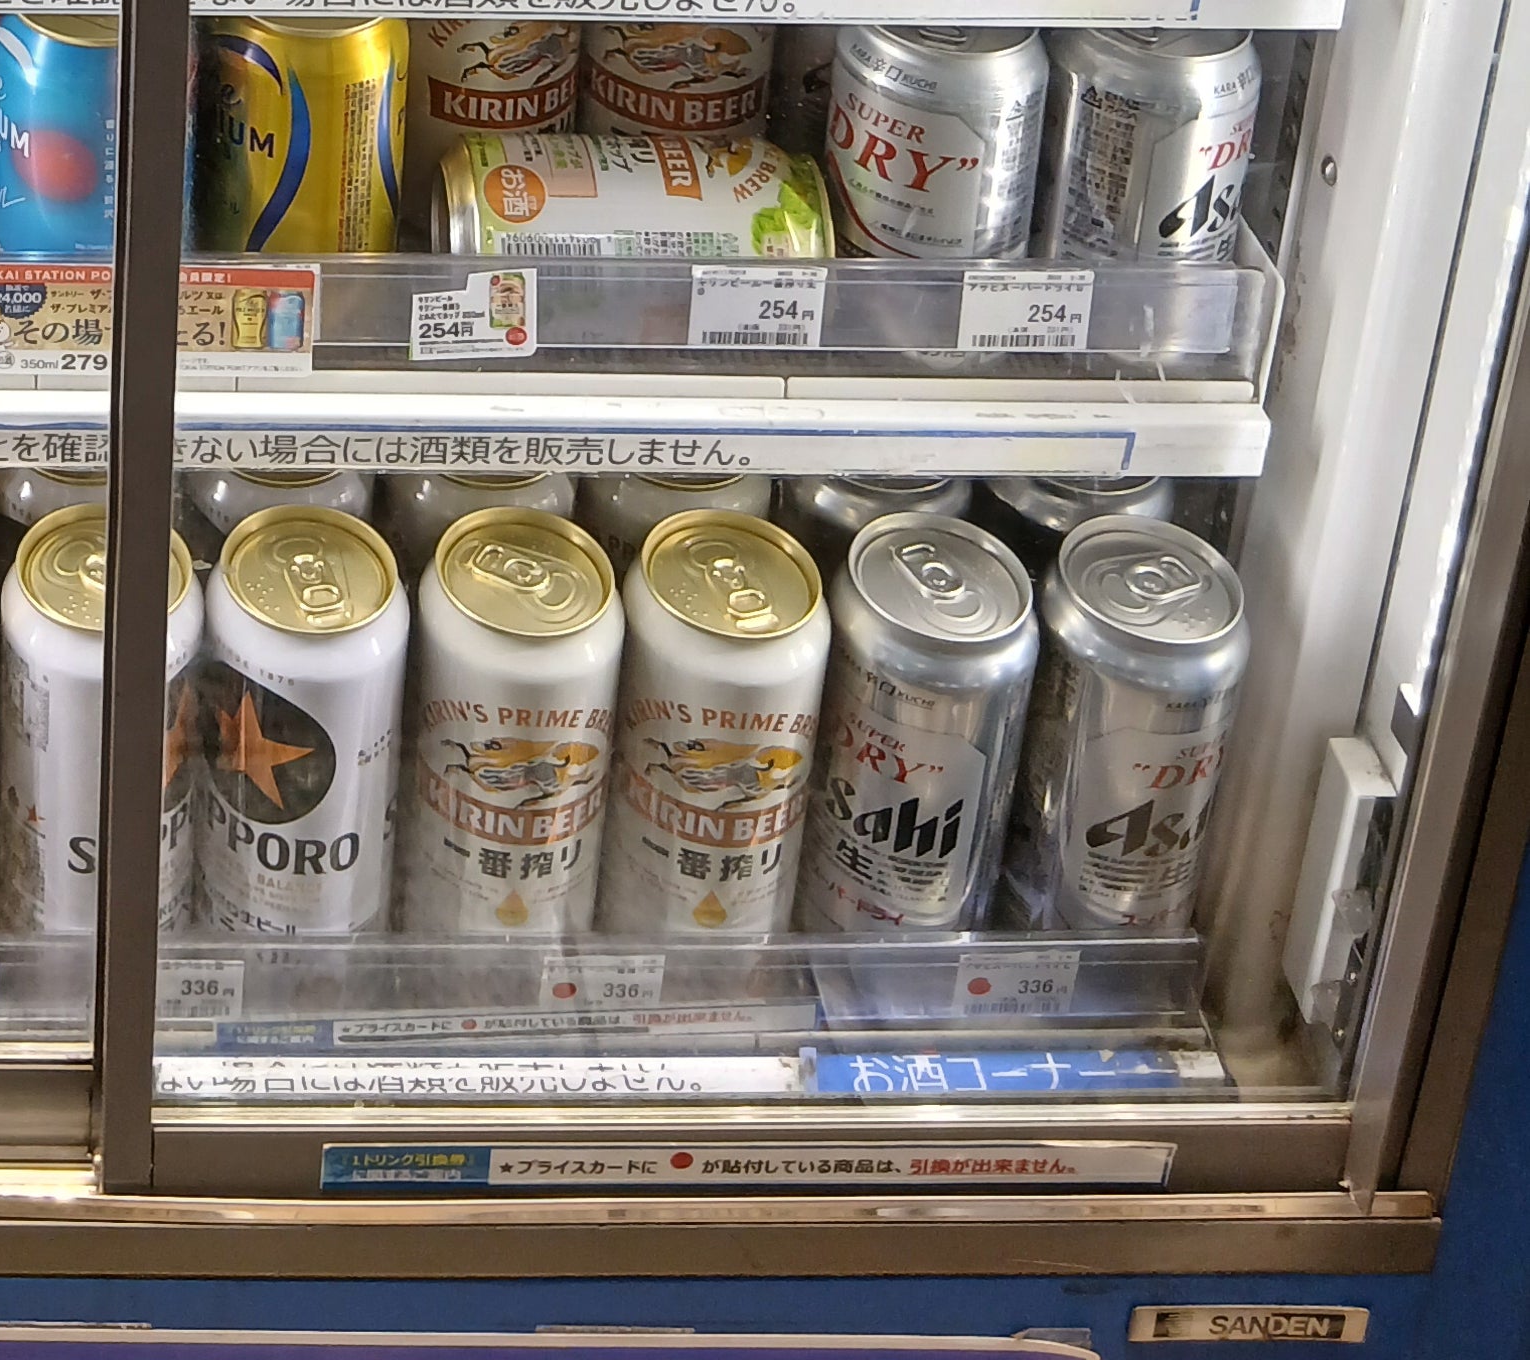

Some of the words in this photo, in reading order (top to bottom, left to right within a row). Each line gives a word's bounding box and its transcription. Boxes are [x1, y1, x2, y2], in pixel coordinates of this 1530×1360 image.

[444, 88, 540, 124] KIRIN
[683, 92, 757, 125] BEER
[846, 93, 926, 144] SUPER
[25, 270, 85, 282] STATION
[498, 707, 573, 730] PRIME
[701, 707, 784, 732] PRIME
[428, 780, 528, 837] KIRIN
[441, 836, 582, 881] 一番搾り
[641, 835, 783, 882] 一番搾り
[1208, 1314, 1331, 1337] SANDEN
